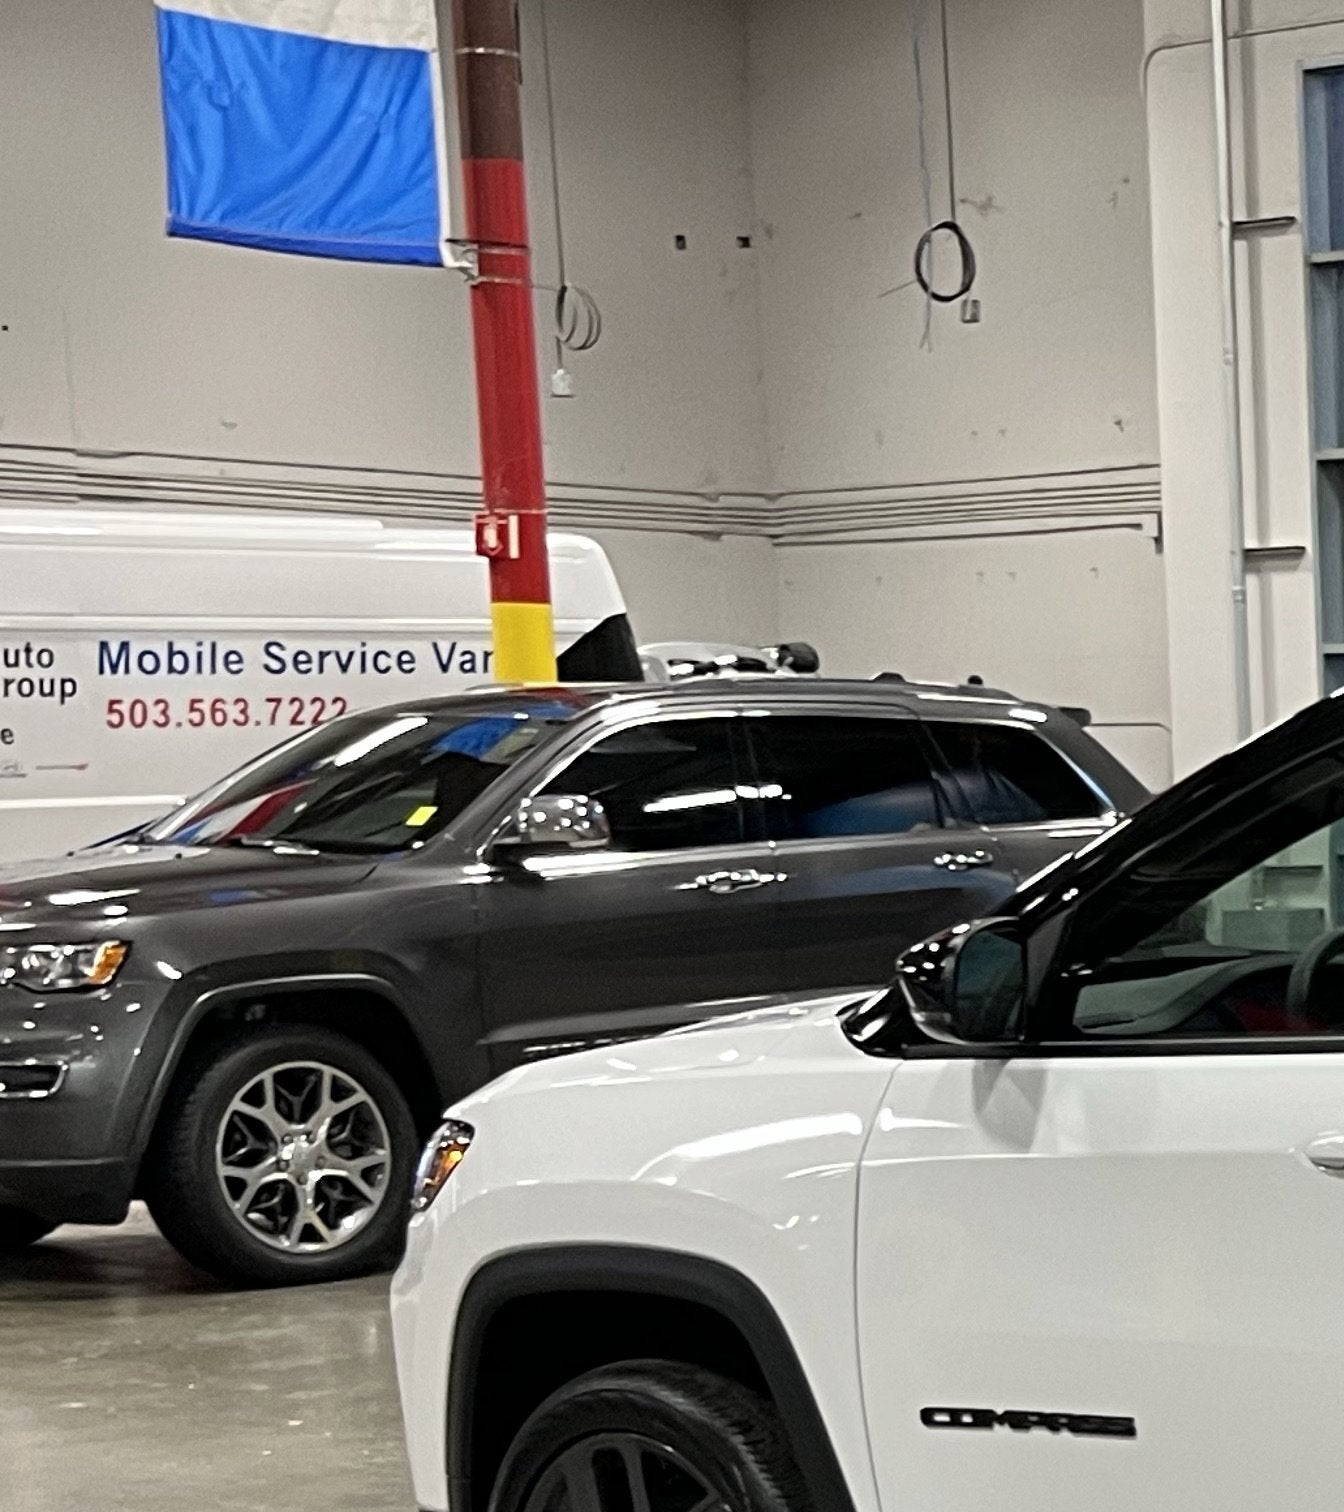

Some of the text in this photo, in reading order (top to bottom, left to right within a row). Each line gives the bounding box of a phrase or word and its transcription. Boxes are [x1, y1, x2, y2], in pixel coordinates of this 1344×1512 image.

[3, 641, 55, 669] uto
[99, 640, 245, 675] Mobile
[262, 640, 417, 675] Service
[3, 677, 78, 706] roup
[106, 696, 347, 729] 503.563.7222
